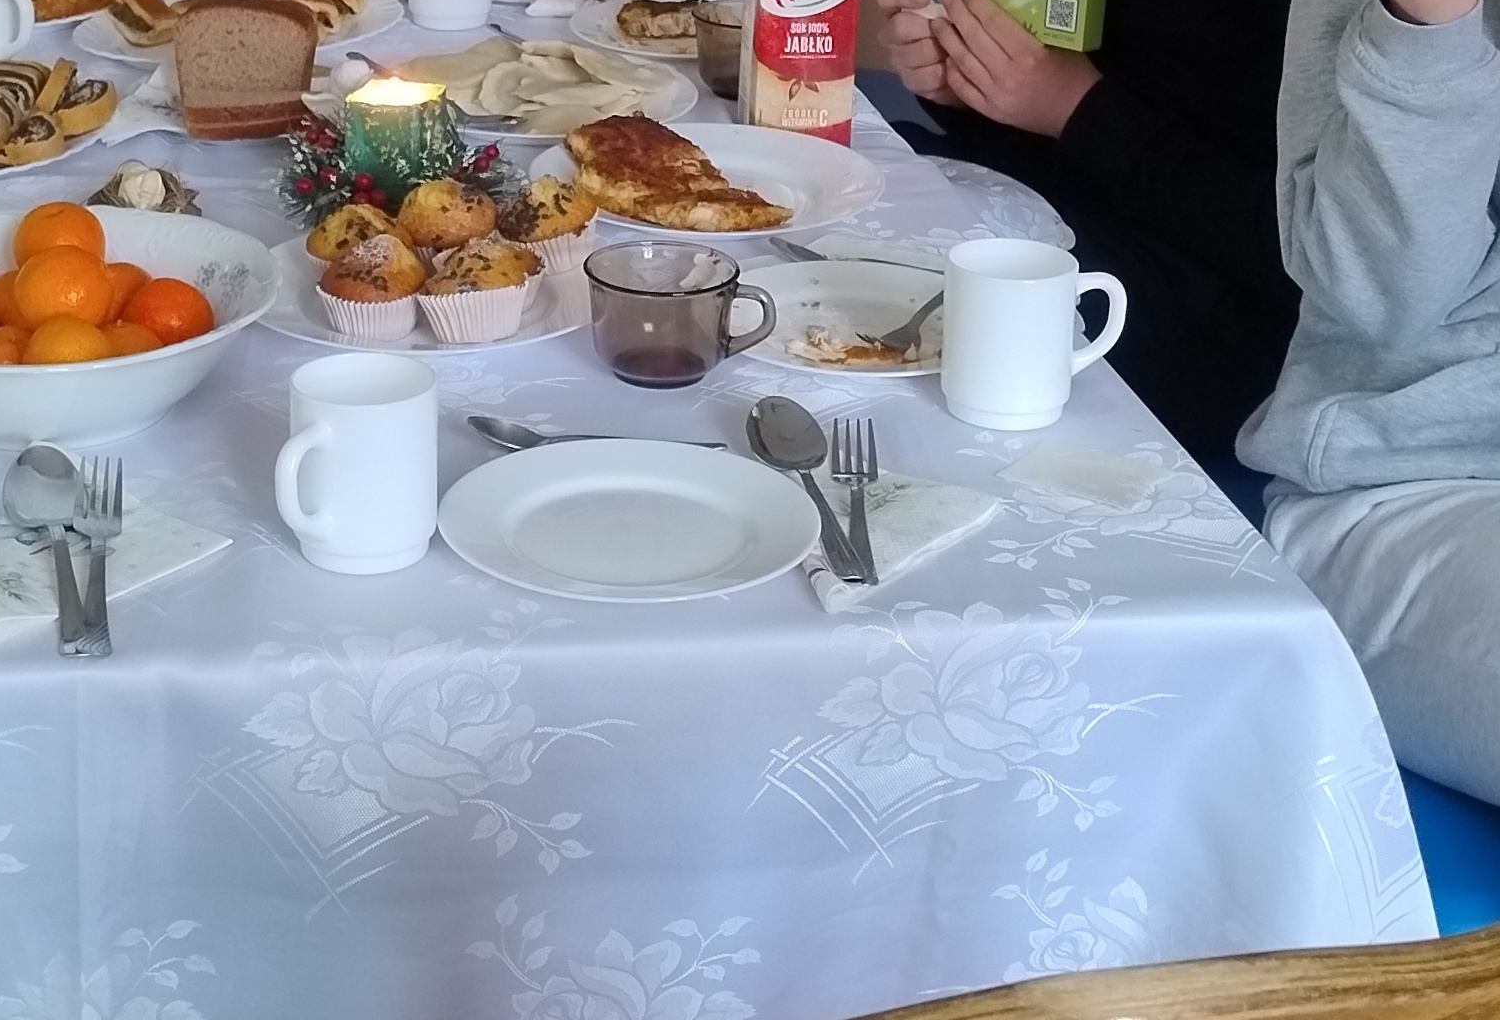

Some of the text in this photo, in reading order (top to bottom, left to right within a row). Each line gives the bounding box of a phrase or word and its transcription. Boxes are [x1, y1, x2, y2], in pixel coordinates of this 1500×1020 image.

[789, 22, 831, 35] SOK 100%
[784, 35, 833, 54] JABŁKO
